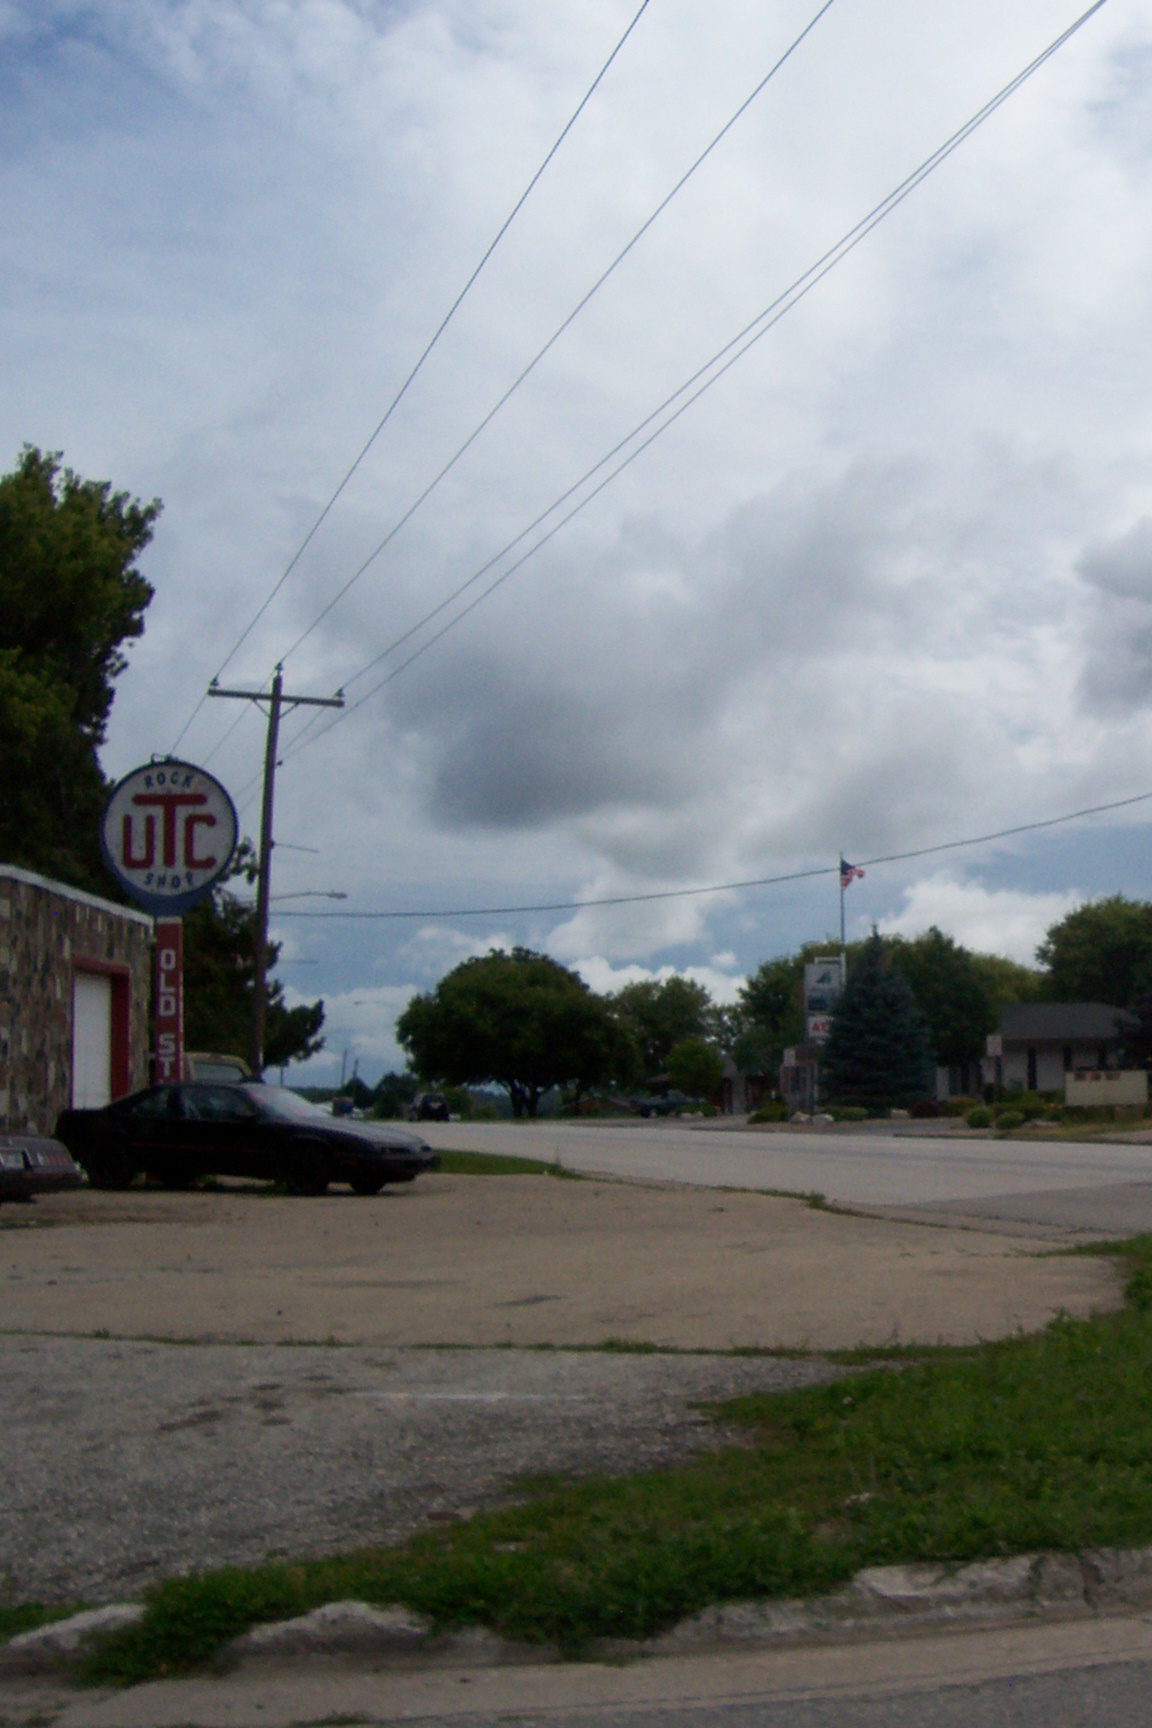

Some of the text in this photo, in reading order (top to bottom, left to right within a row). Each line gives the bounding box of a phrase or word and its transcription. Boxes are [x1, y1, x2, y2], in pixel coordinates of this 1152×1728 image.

[145, 771, 194, 789] ROCK
[158, 948, 176, 1083] OLD ST
